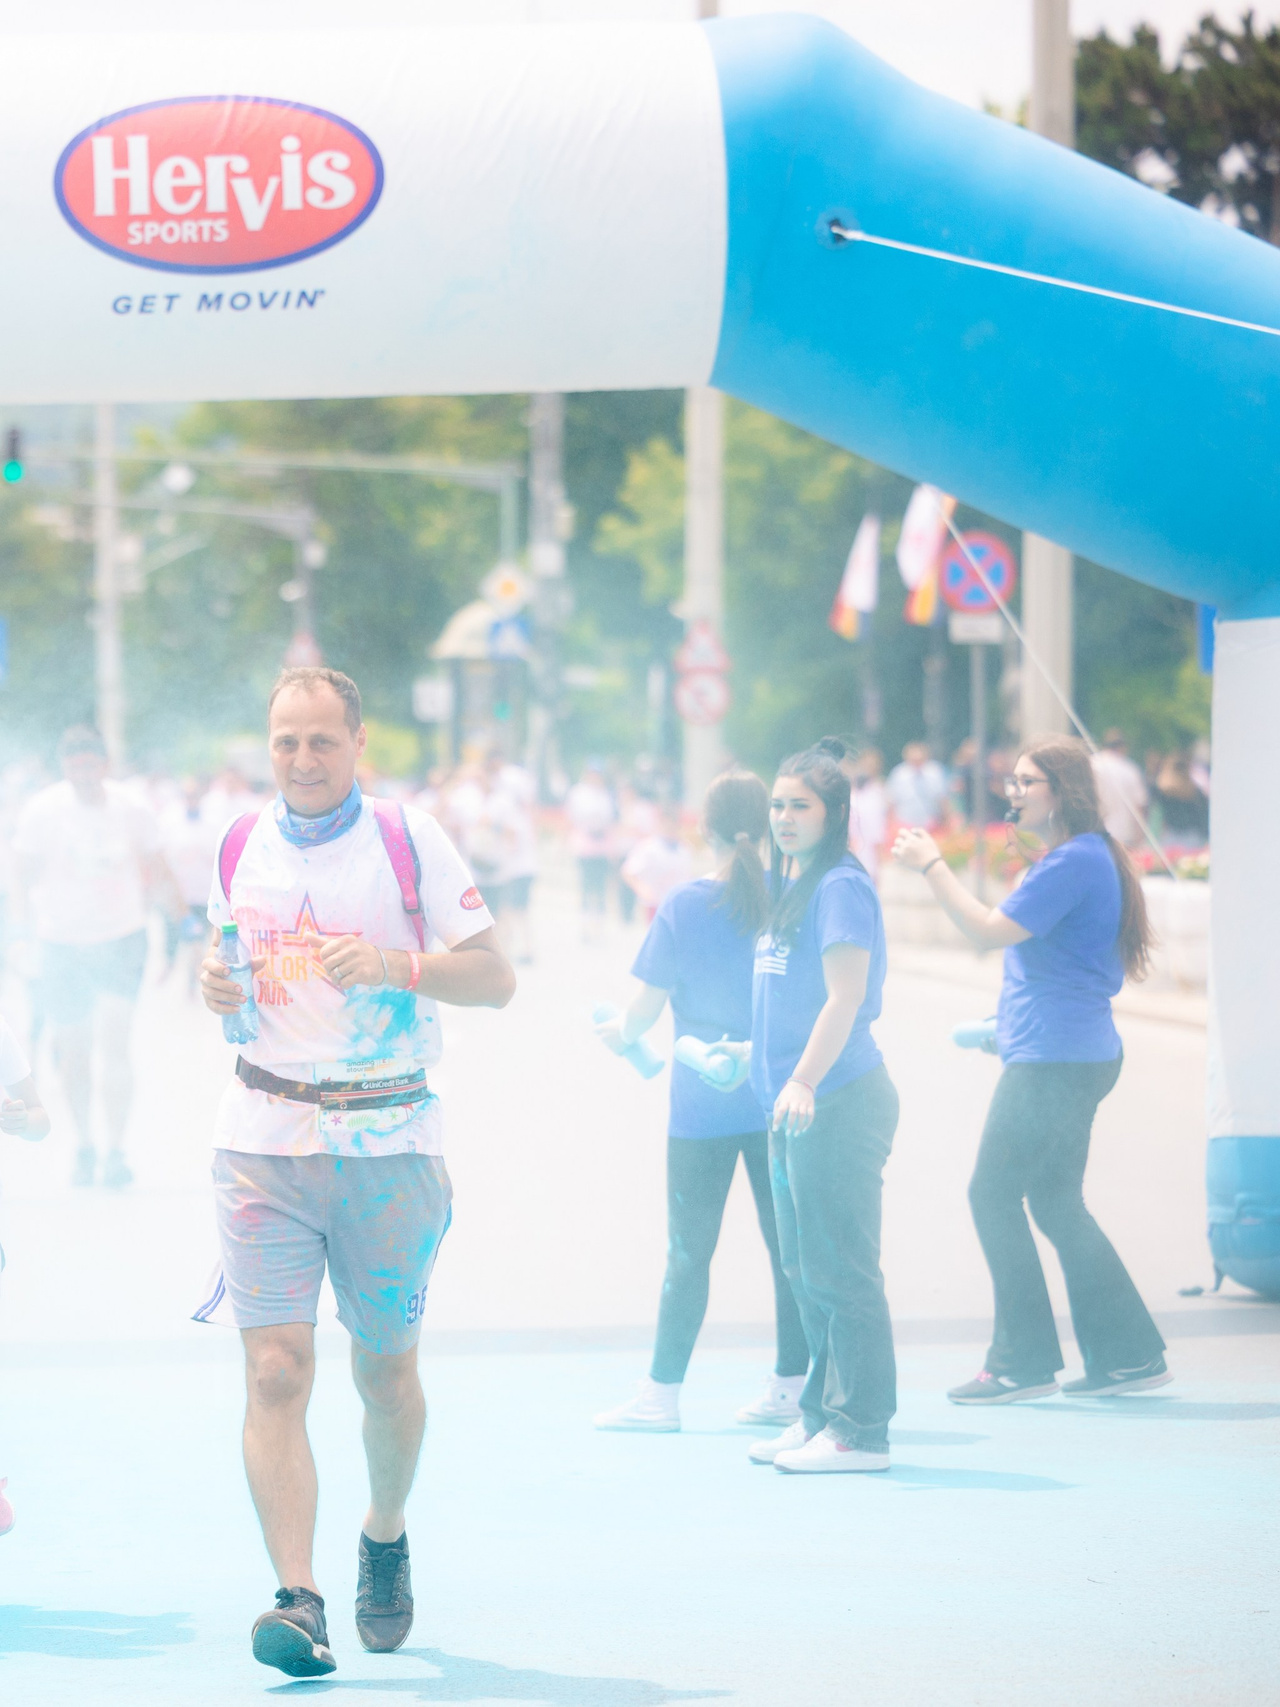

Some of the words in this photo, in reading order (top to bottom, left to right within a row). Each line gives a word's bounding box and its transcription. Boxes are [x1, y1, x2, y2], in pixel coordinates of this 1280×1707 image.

[91, 134, 357, 231] Hervis
[127, 217, 229, 246] SPORTS
[111, 293, 181, 315] GET
[250, 928, 279, 955] THE
[257, 980, 288, 1006] RUN
[369, 1080, 395, 1089] UniCredit
